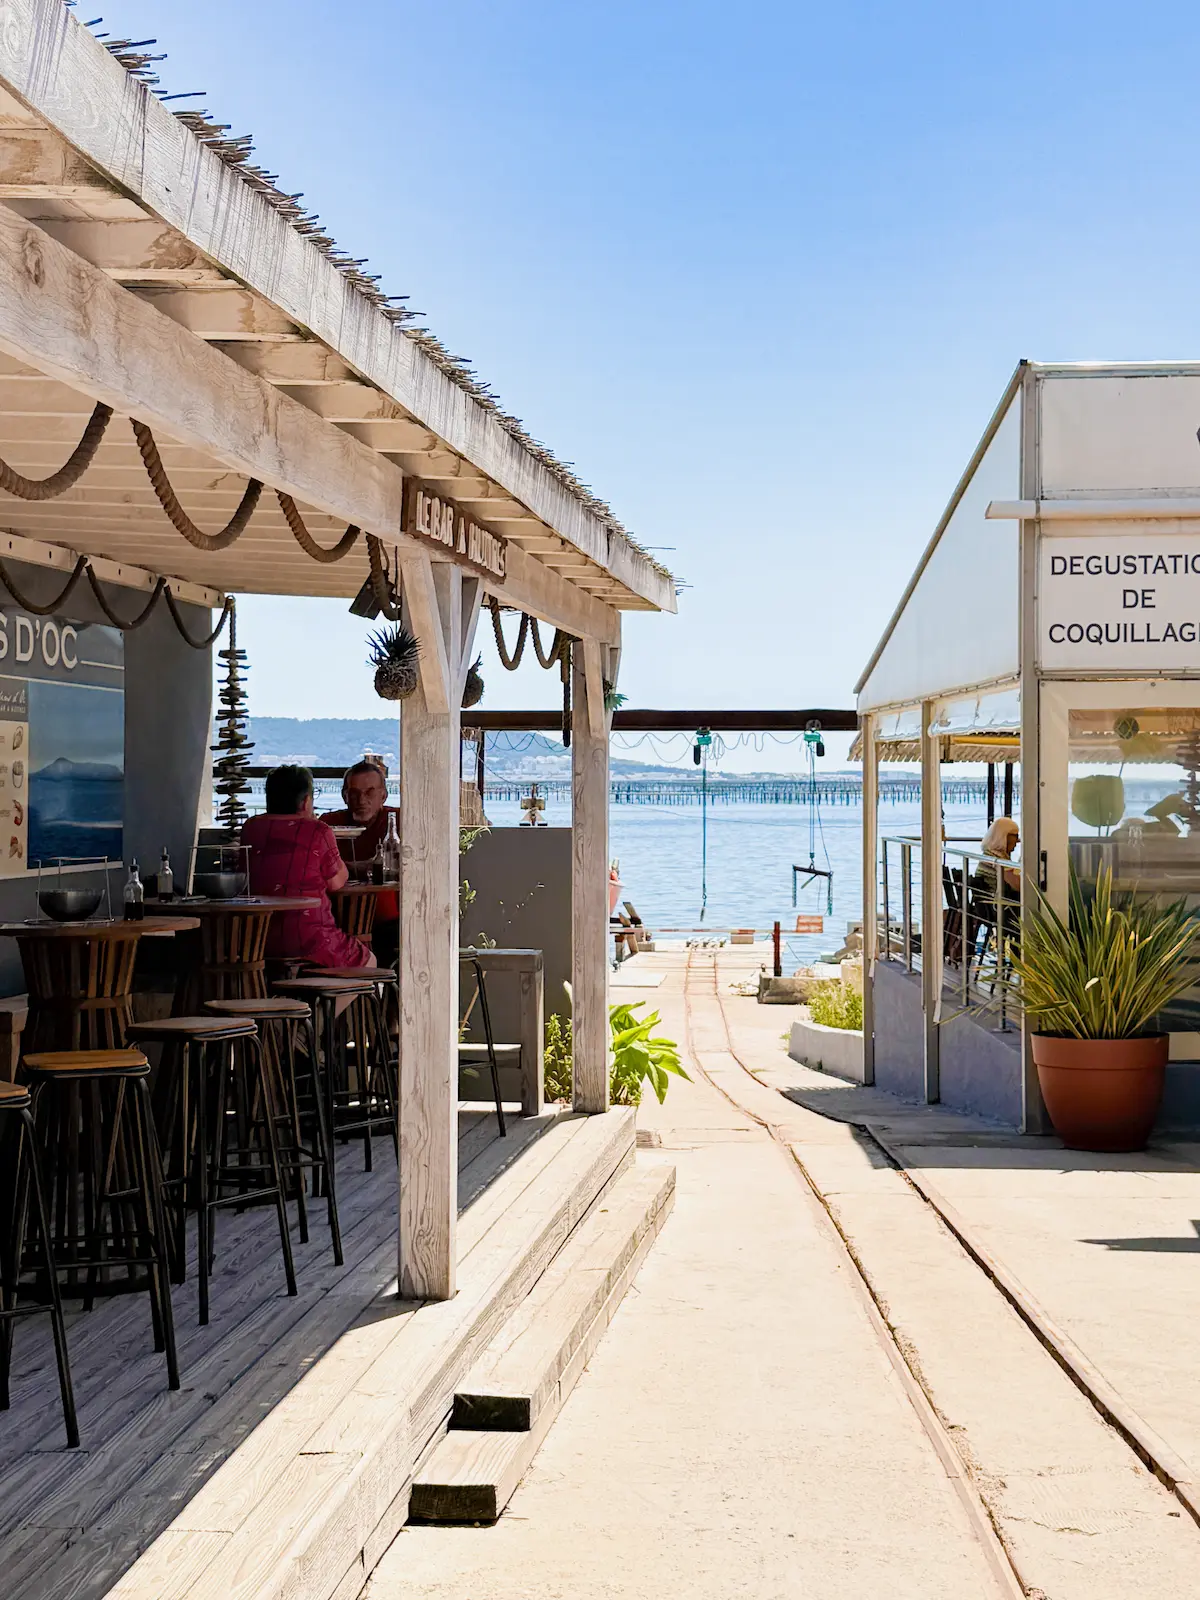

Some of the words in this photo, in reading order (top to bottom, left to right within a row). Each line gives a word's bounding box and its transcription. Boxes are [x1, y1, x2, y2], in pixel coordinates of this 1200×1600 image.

[416, 491, 431, 535] LE
[431, 497, 454, 547] BAR
[456, 517, 467, 554] A
[1122, 588, 1156, 609] DE
[1049, 622, 1200, 646] COQUILLAG
